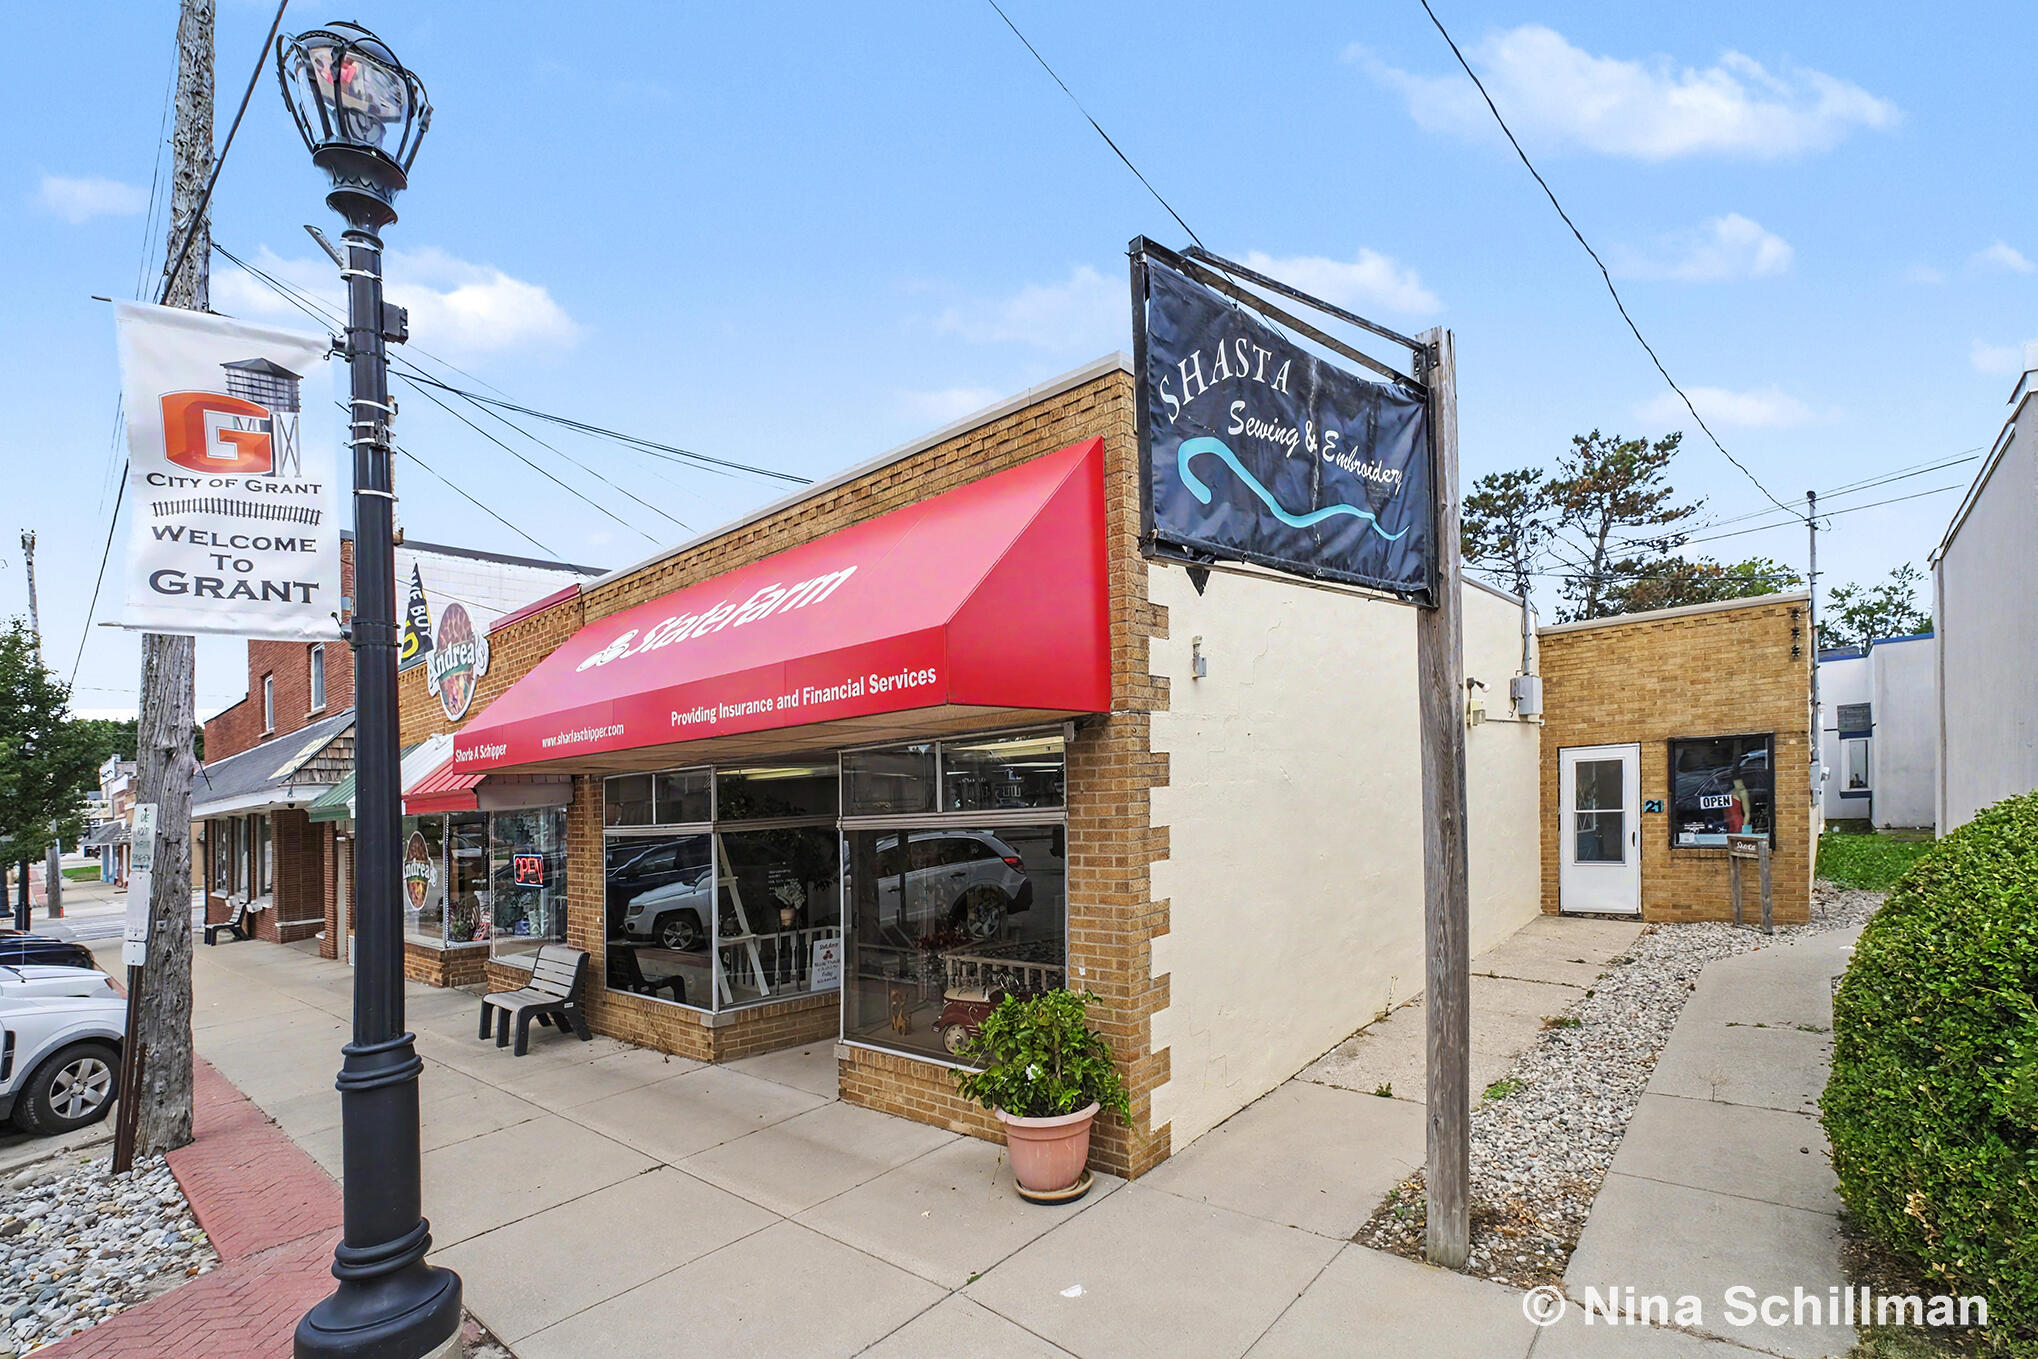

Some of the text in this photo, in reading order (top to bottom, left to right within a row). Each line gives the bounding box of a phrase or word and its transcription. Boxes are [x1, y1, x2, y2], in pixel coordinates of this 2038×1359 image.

[1159, 337, 1292, 424] SHASTA
[1228, 400, 1405, 495] Sewing & Embroidery
[146, 472, 202, 488] CITY
[245, 479, 322, 495] GRANT
[151, 525, 317, 553] WELCOME
[209, 552, 254, 573] TO
[149, 569, 320, 604] GRANT
[671, 667, 937, 727] Providing Insurance and Financial Services
[480, 743, 507, 761] Schipper
[1645, 799, 1662, 813] 21
[1703, 795, 1731, 808] OPEN
[515, 857, 544, 884] OPEN
